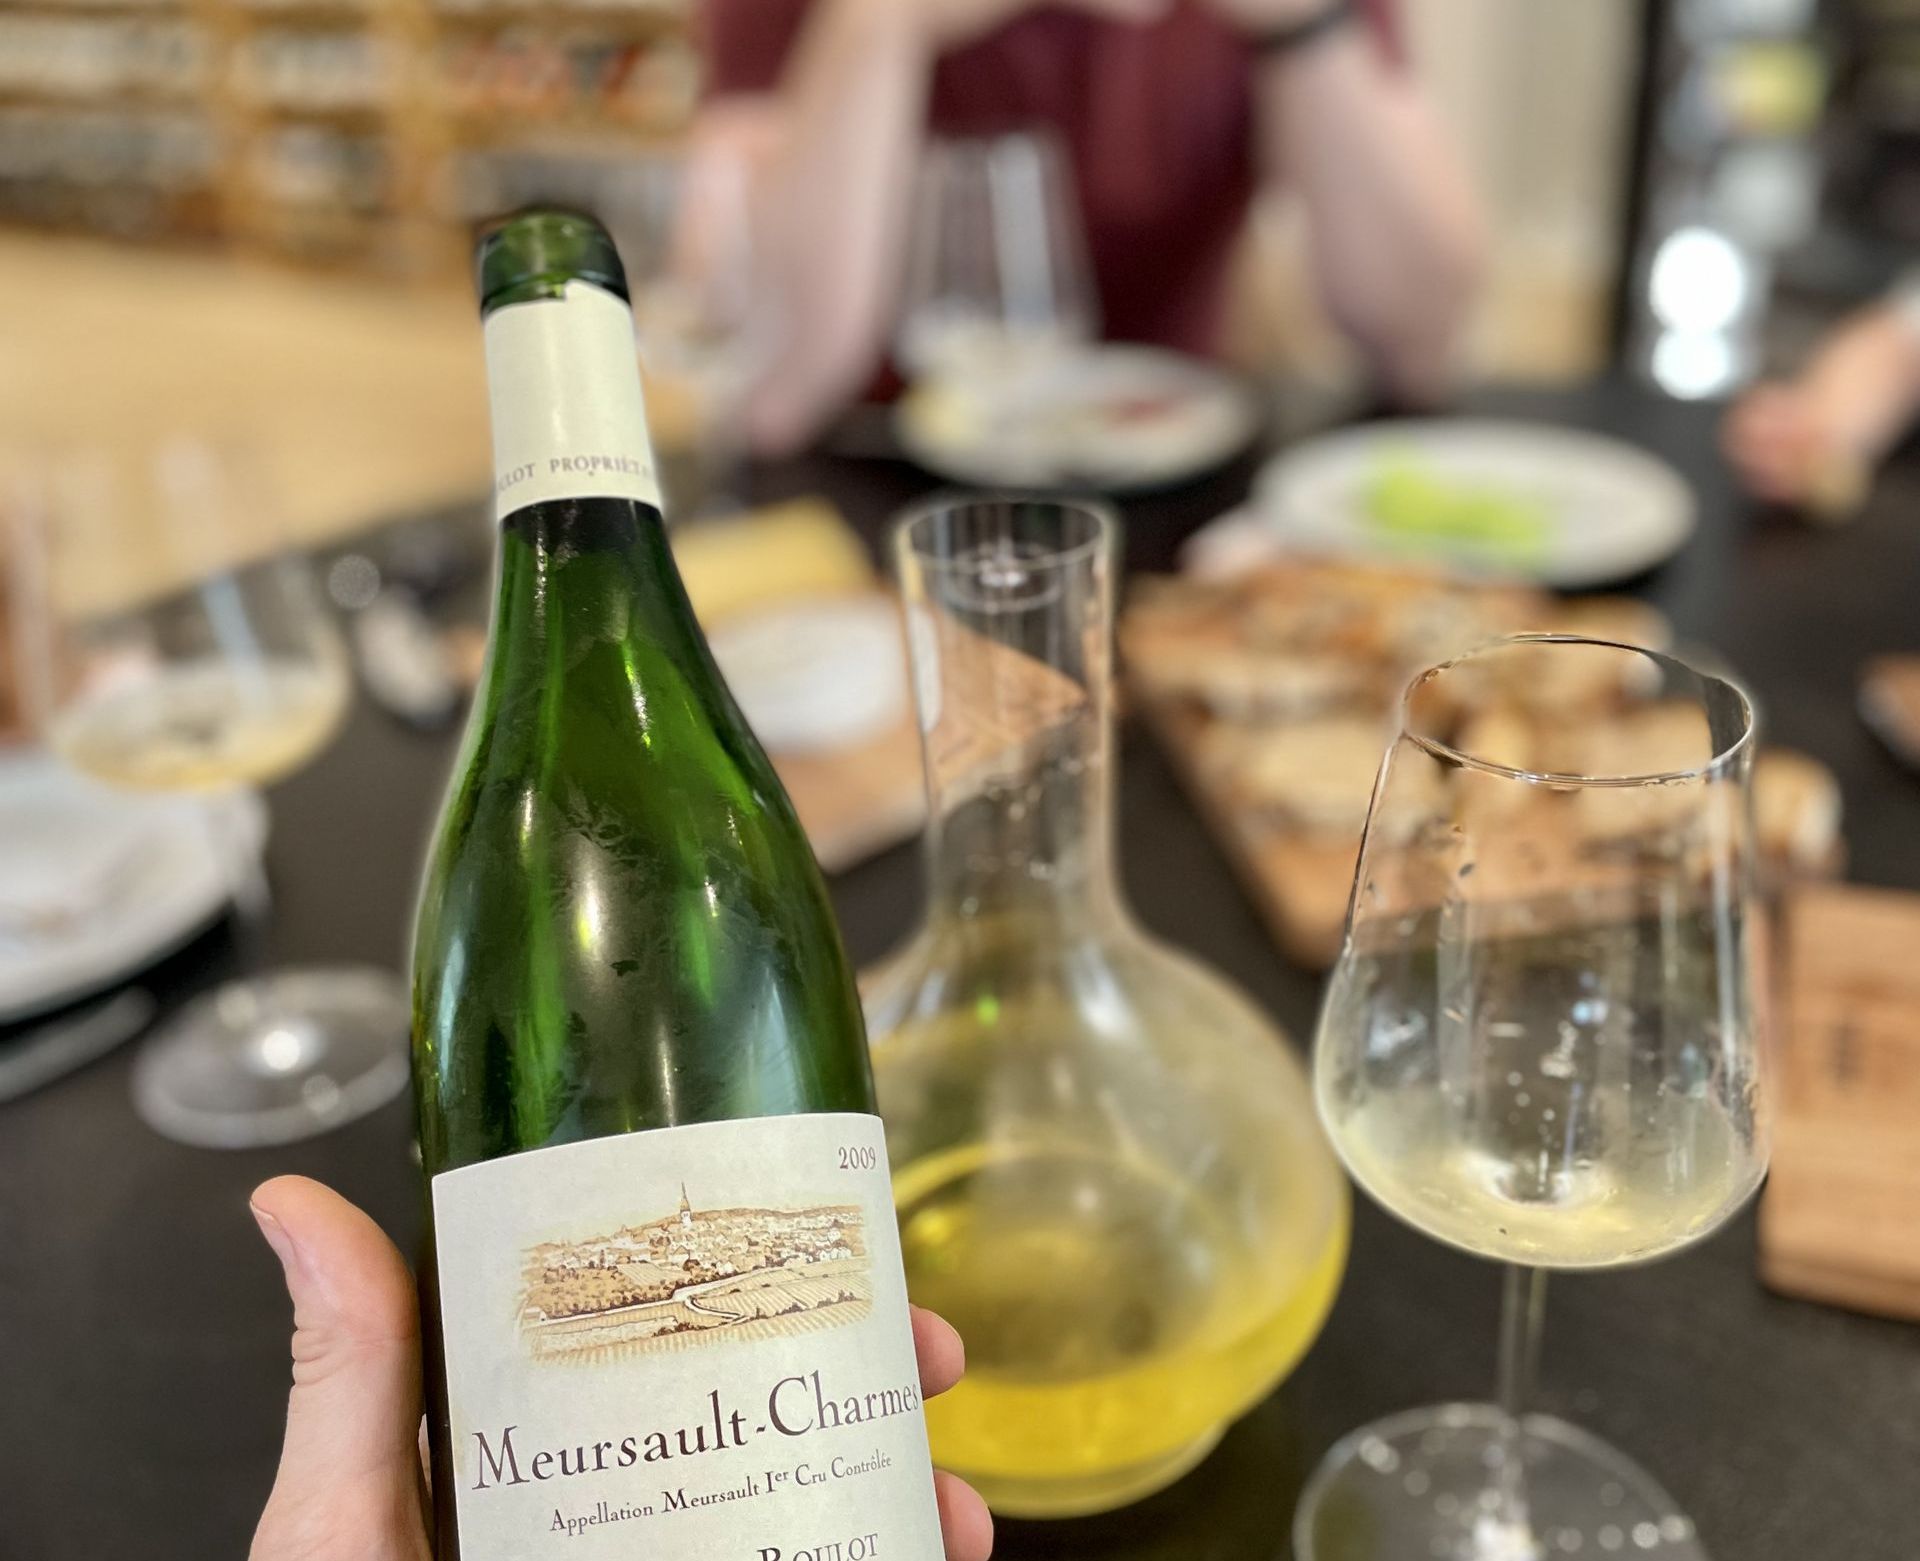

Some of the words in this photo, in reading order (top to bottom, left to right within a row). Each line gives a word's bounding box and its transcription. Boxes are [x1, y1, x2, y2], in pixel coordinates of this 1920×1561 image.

[838, 1146, 876, 1170] 2009
[471, 1369, 918, 1491] Meursault-Charmes
[550, 1502, 654, 1537] Appellation
[661, 1475, 760, 1514] Meursault
[795, 1463, 826, 1486] Cru
[831, 1448, 892, 1479] Contrôlée
